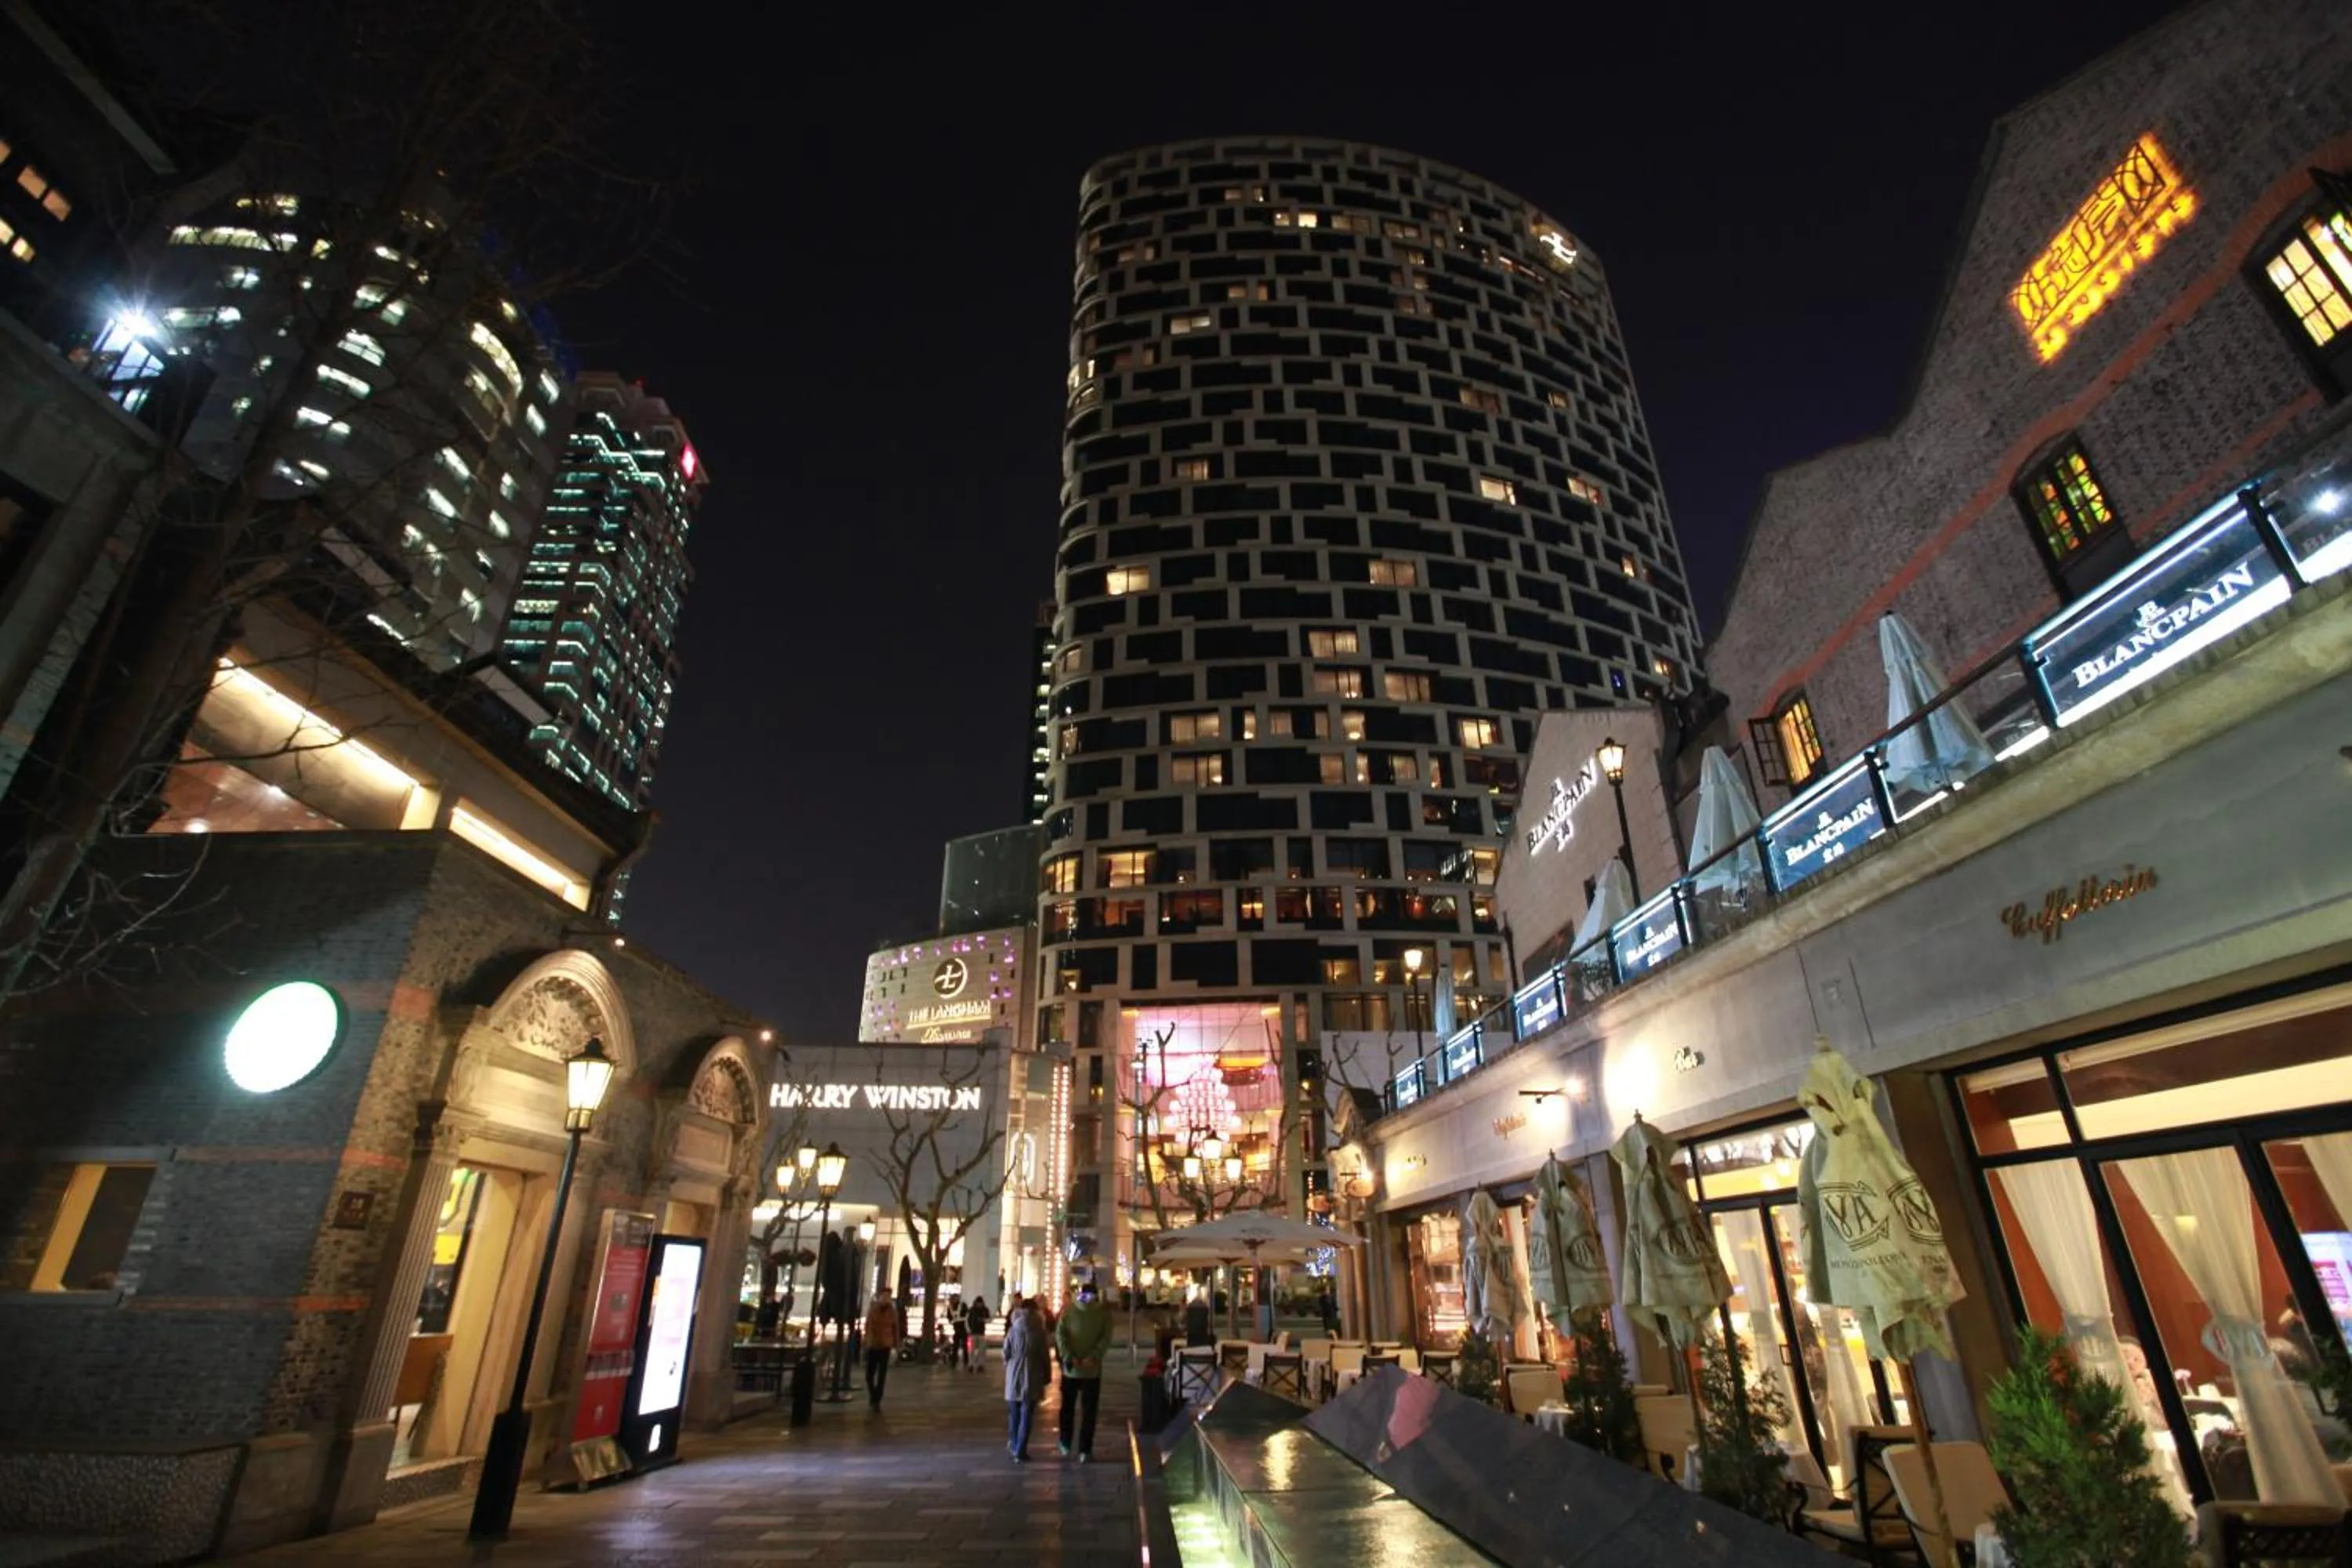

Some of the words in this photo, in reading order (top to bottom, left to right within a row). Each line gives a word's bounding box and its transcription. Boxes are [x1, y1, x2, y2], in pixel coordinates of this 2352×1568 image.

[2071, 562, 2255, 688] BLANCPAIN
[1527, 757, 1597, 855] BLANCPAIN
[1785, 798, 1875, 866] BLANCPAIN
[864, 1085, 981, 1110] WINSTON
